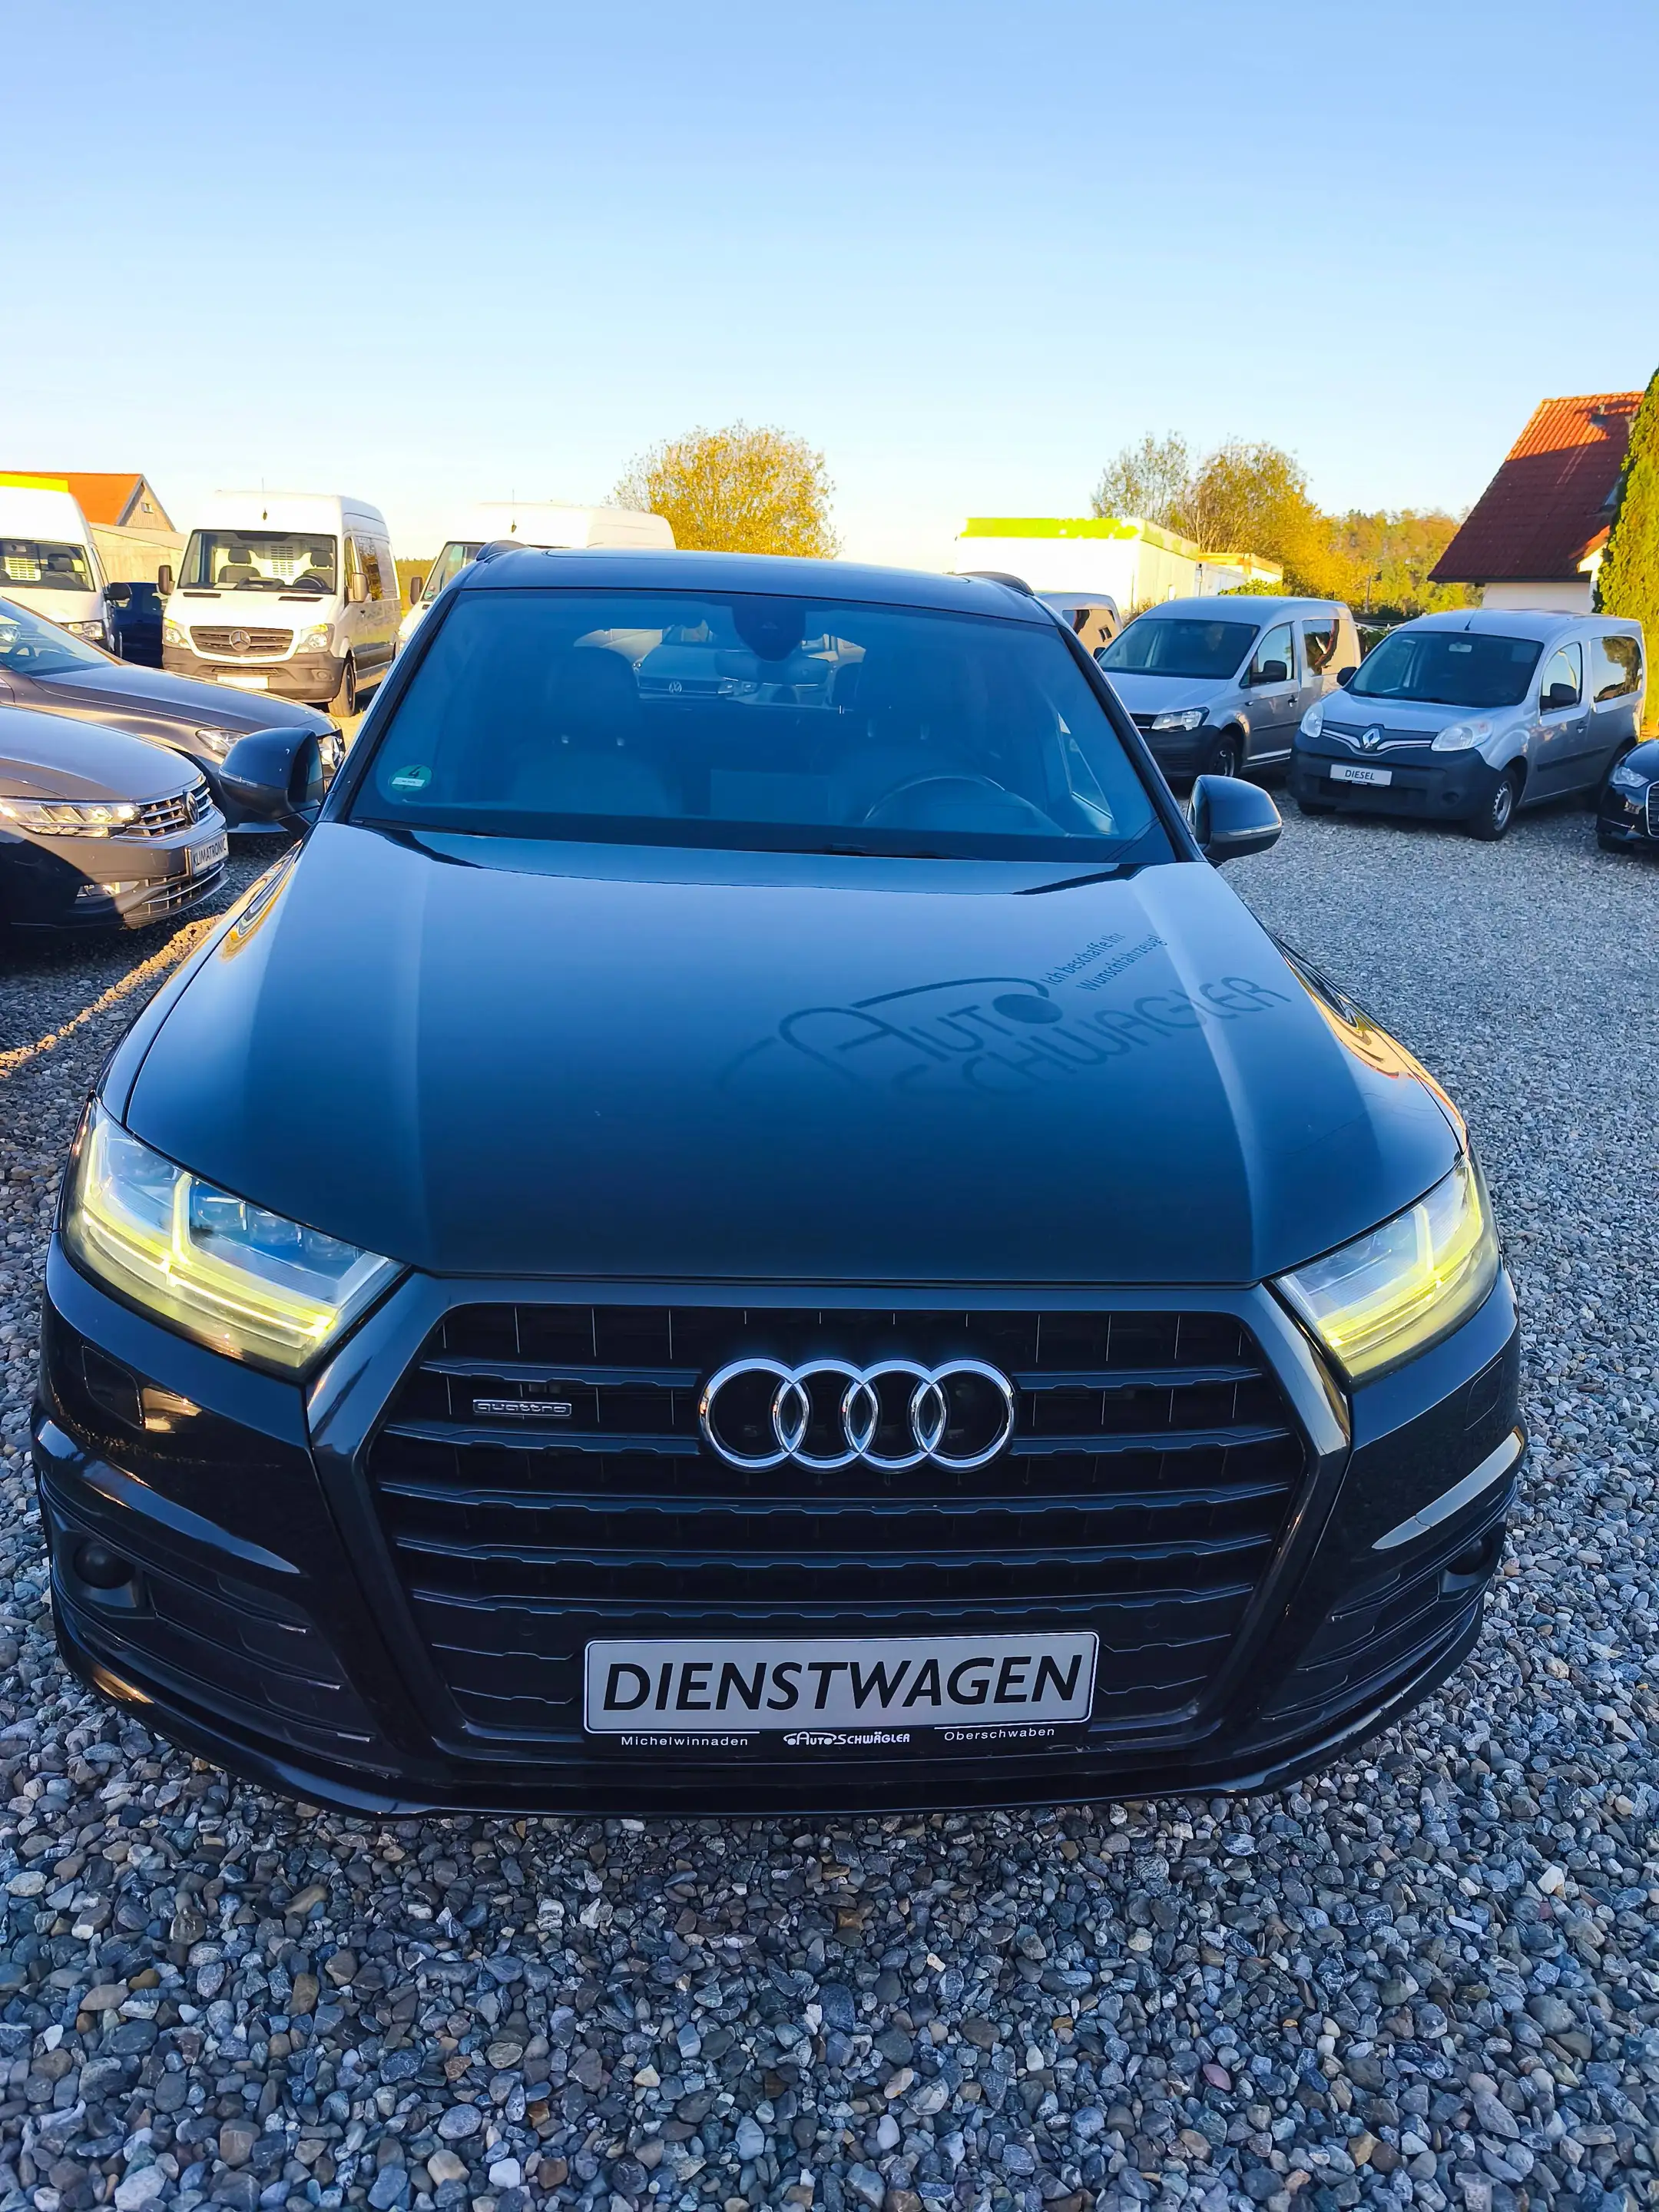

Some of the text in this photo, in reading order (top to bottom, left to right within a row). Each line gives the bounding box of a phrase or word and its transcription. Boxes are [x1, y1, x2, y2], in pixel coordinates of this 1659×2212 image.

[1345, 770, 1375, 780] DIESEL
[194, 837, 227, 867] KLIMATRONIC
[1039, 932, 1126, 985] Ich beschaffe Ihr
[476, 1402, 568, 1414] quattro
[603, 1654, 1083, 1710] DIENSTWAGEN
[621, 1736, 749, 1747] Michelwinnaden
[944, 1728, 1055, 1741] Oberschwaben
